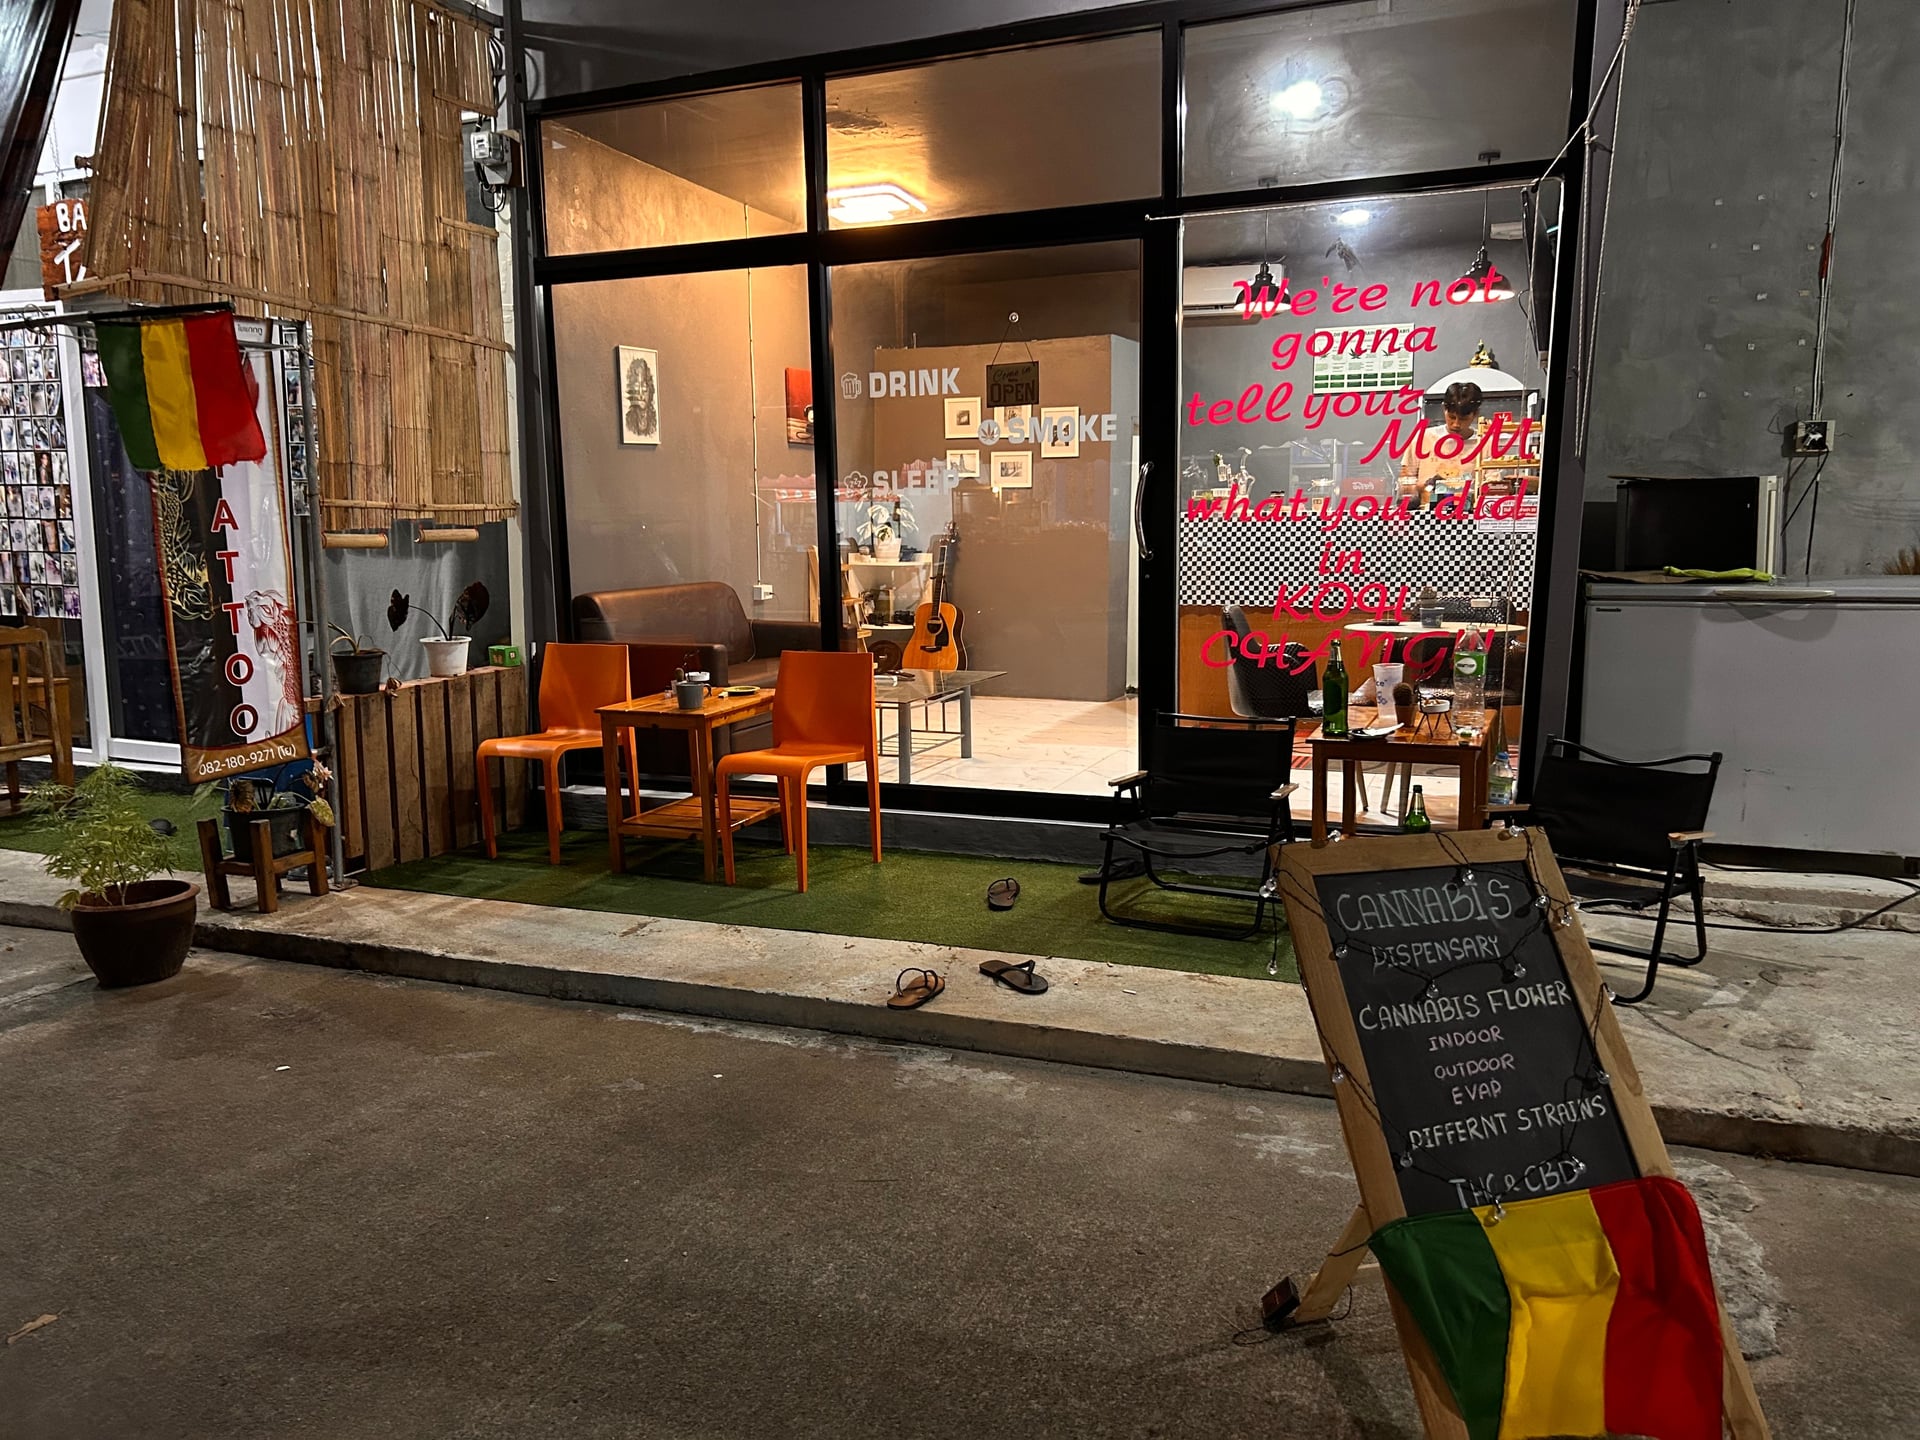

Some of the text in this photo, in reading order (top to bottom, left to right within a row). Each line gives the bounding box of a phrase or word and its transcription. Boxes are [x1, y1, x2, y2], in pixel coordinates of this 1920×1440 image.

[56, 203, 88, 232] BA
[1232, 266, 1503, 320] We're not
[1271, 326, 1438, 371] gonna
[869, 367, 960, 398] DRINK
[991, 380, 1035, 403] OPEN
[1186, 382, 1424, 430] tell your
[1007, 414, 1118, 444] SMOKE
[872, 470, 960, 497] SLEEP
[1187, 484, 1308, 523] what
[1318, 494, 1411, 531] you
[1434, 479, 1528, 521] did
[1318, 541, 1366, 576] in
[211, 463, 258, 736] ATTOO
[199, 749, 275, 775] 082-180-9271
[1337, 879, 1513, 932] CANNABIS
[1373, 935, 1501, 974] DISPENSARY
[1359, 980, 1571, 1031] CANNABIS FLOWER
[1429, 1025, 1504, 1052] INDOOR
[1434, 1053, 1516, 1080] OUTDOOR
[1408, 1095, 1607, 1150] DIFFERNT STRAINS
[1449, 1173, 1501, 1208] THC
[1524, 1160, 1580, 1192] CBD
